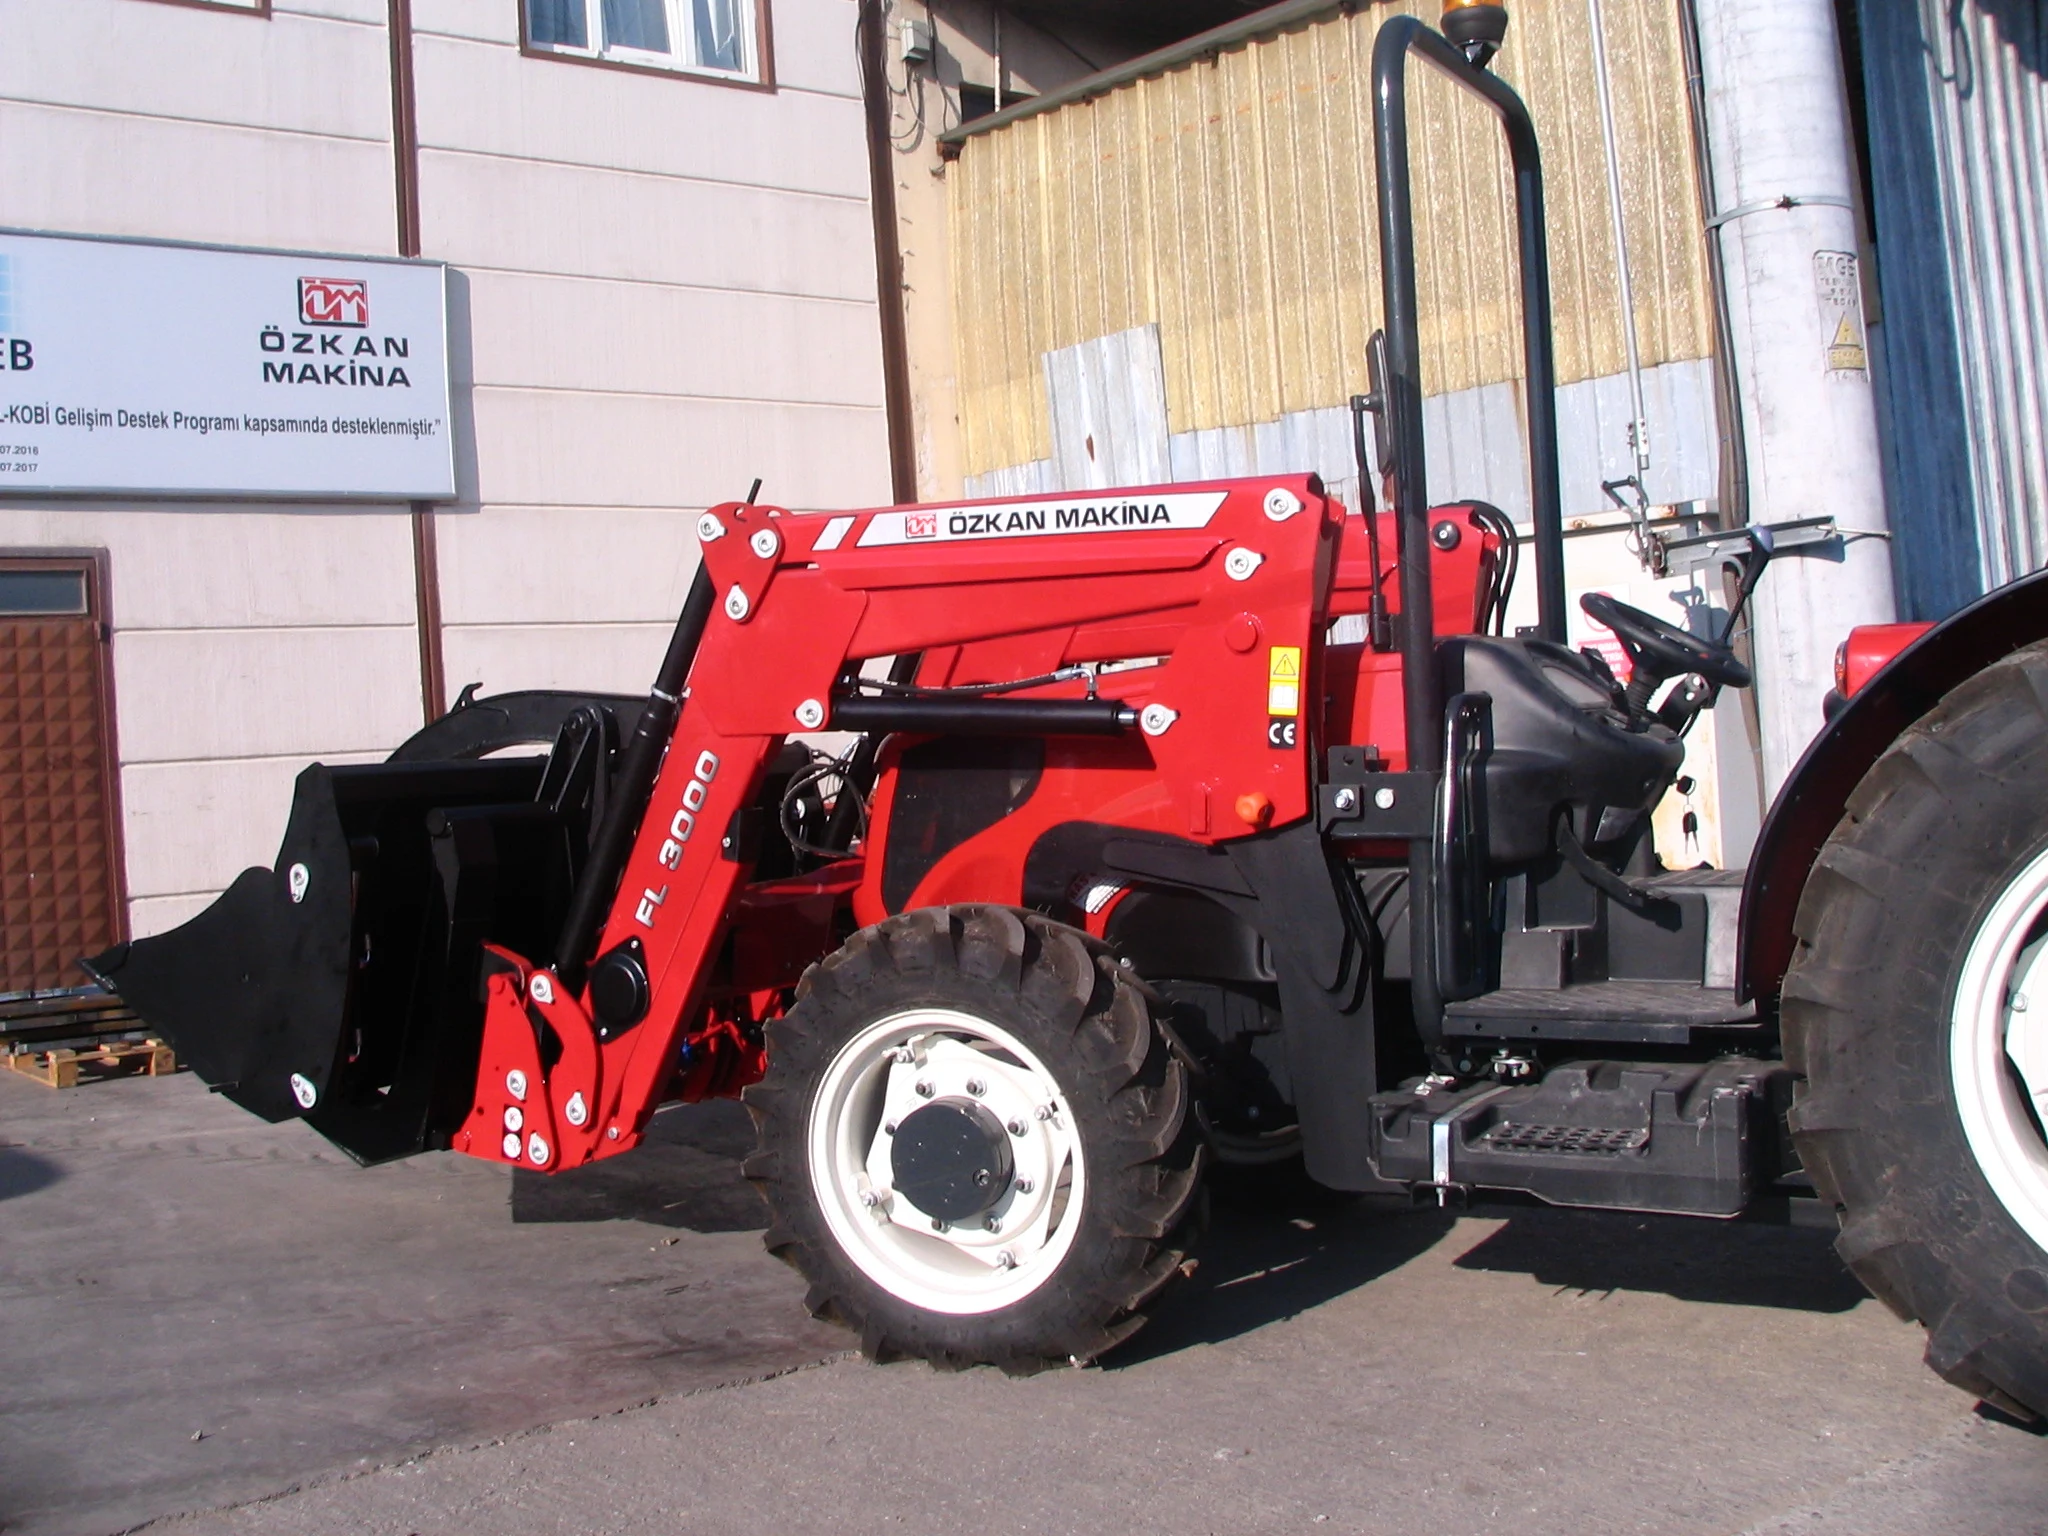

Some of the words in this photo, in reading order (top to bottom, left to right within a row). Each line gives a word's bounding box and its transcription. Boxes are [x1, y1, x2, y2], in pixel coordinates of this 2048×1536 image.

[0, 338, 34, 371] B
[260, 325, 409, 358] ÖZKAN
[263, 359, 411, 388] MAKİNA
[55, 406, 113, 432] Gelişim
[117, 409, 169, 429] Destek
[173, 411, 240, 435] Programı
[243, 414, 328, 436] kapsamında
[949, 510, 1046, 535] ÖZKAN
[1055, 501, 1171, 529] MAKİNA
[1268, 722, 1295, 745] CE
[634, 884, 669, 929] FL
[657, 749, 720, 872] 3000
